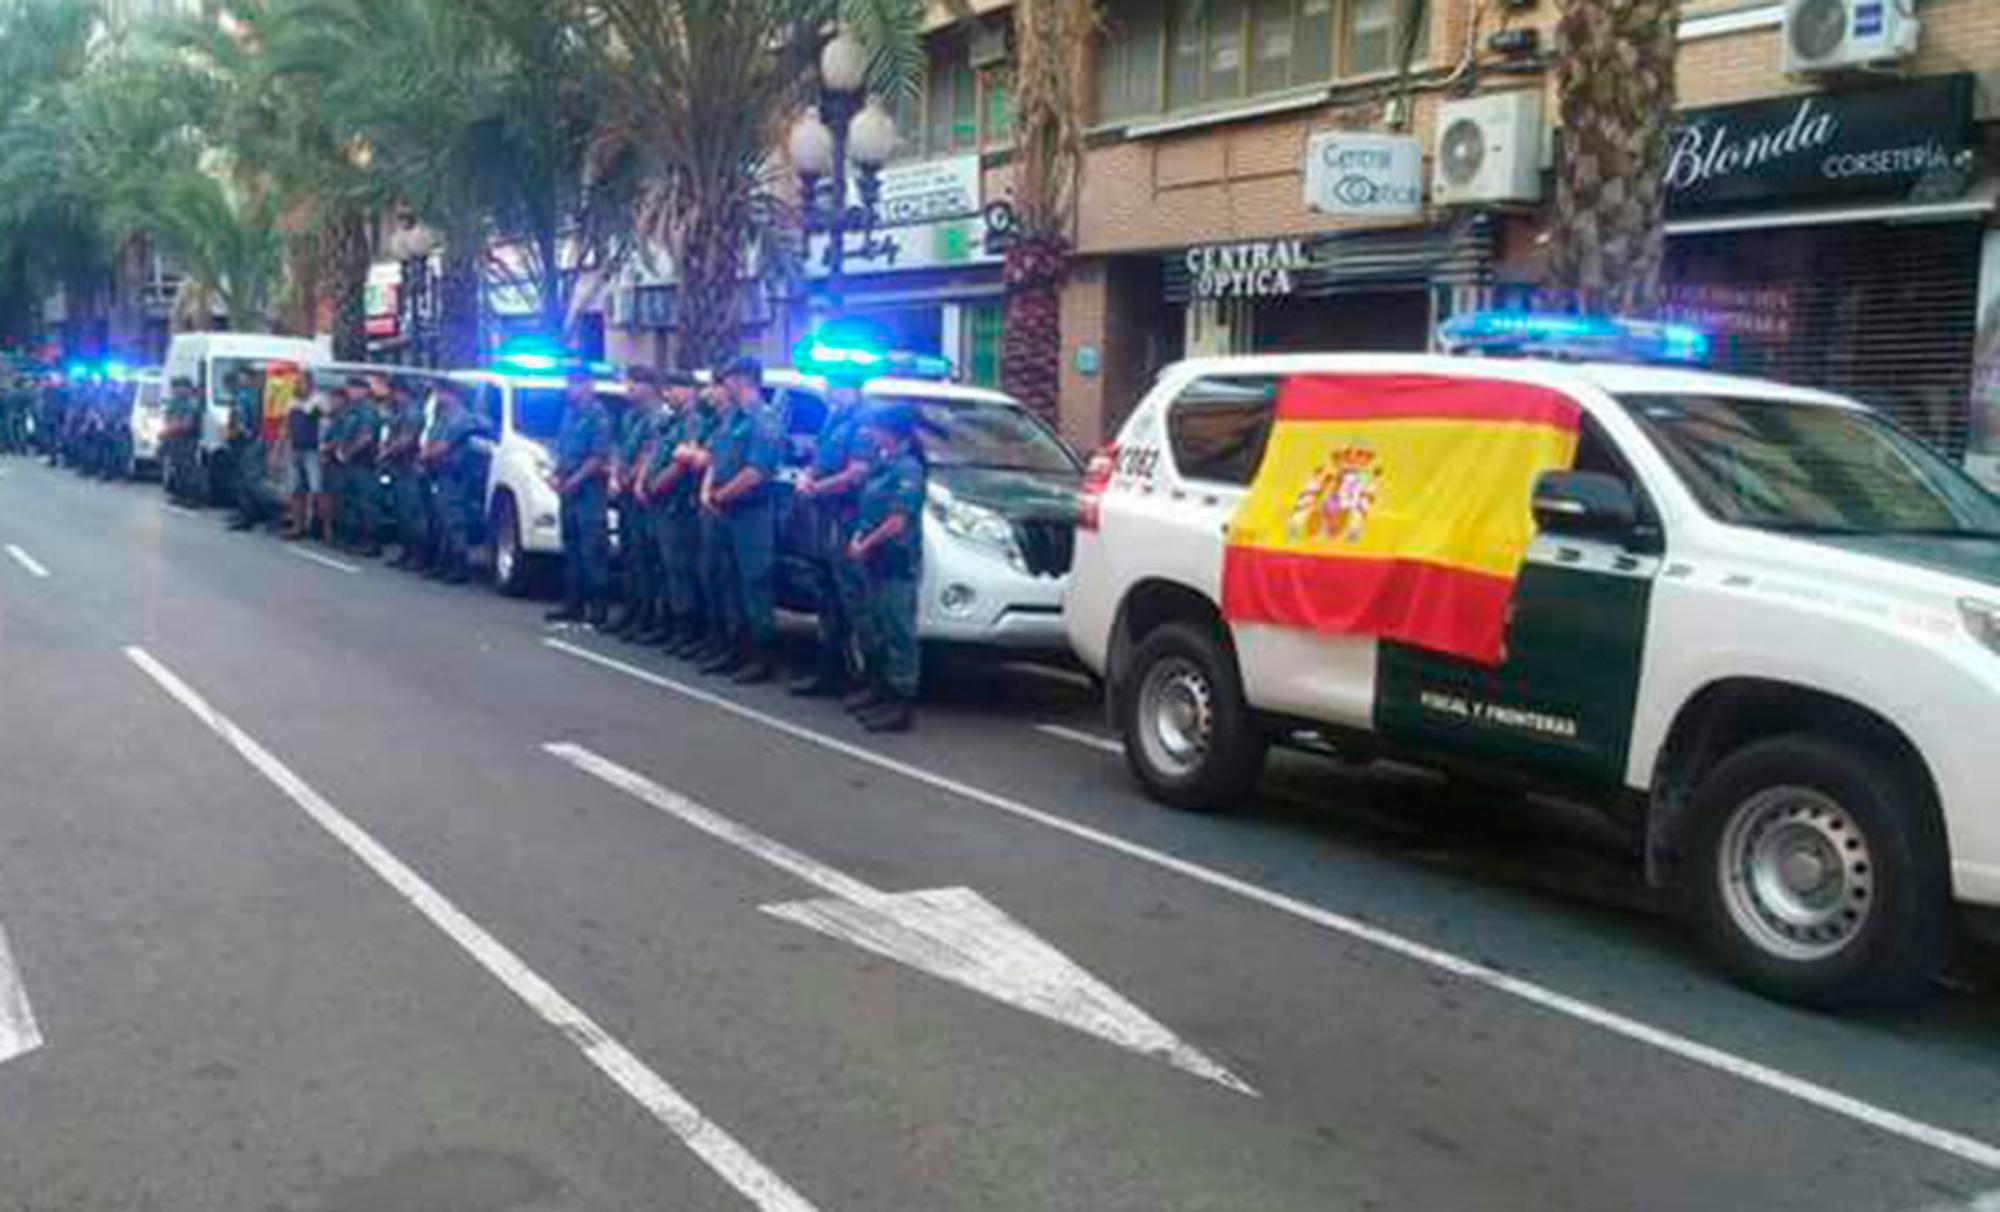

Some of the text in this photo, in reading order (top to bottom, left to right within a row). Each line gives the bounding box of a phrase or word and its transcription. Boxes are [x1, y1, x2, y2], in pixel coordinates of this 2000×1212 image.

[1323, 142, 1392, 170] Central
[1663, 98, 1837, 188] Blonda
[1186, 240, 1312, 273] CENTRAL
[1420, 690, 1468, 716] FISCAL
[1487, 704, 1578, 737] FRONTERAS
